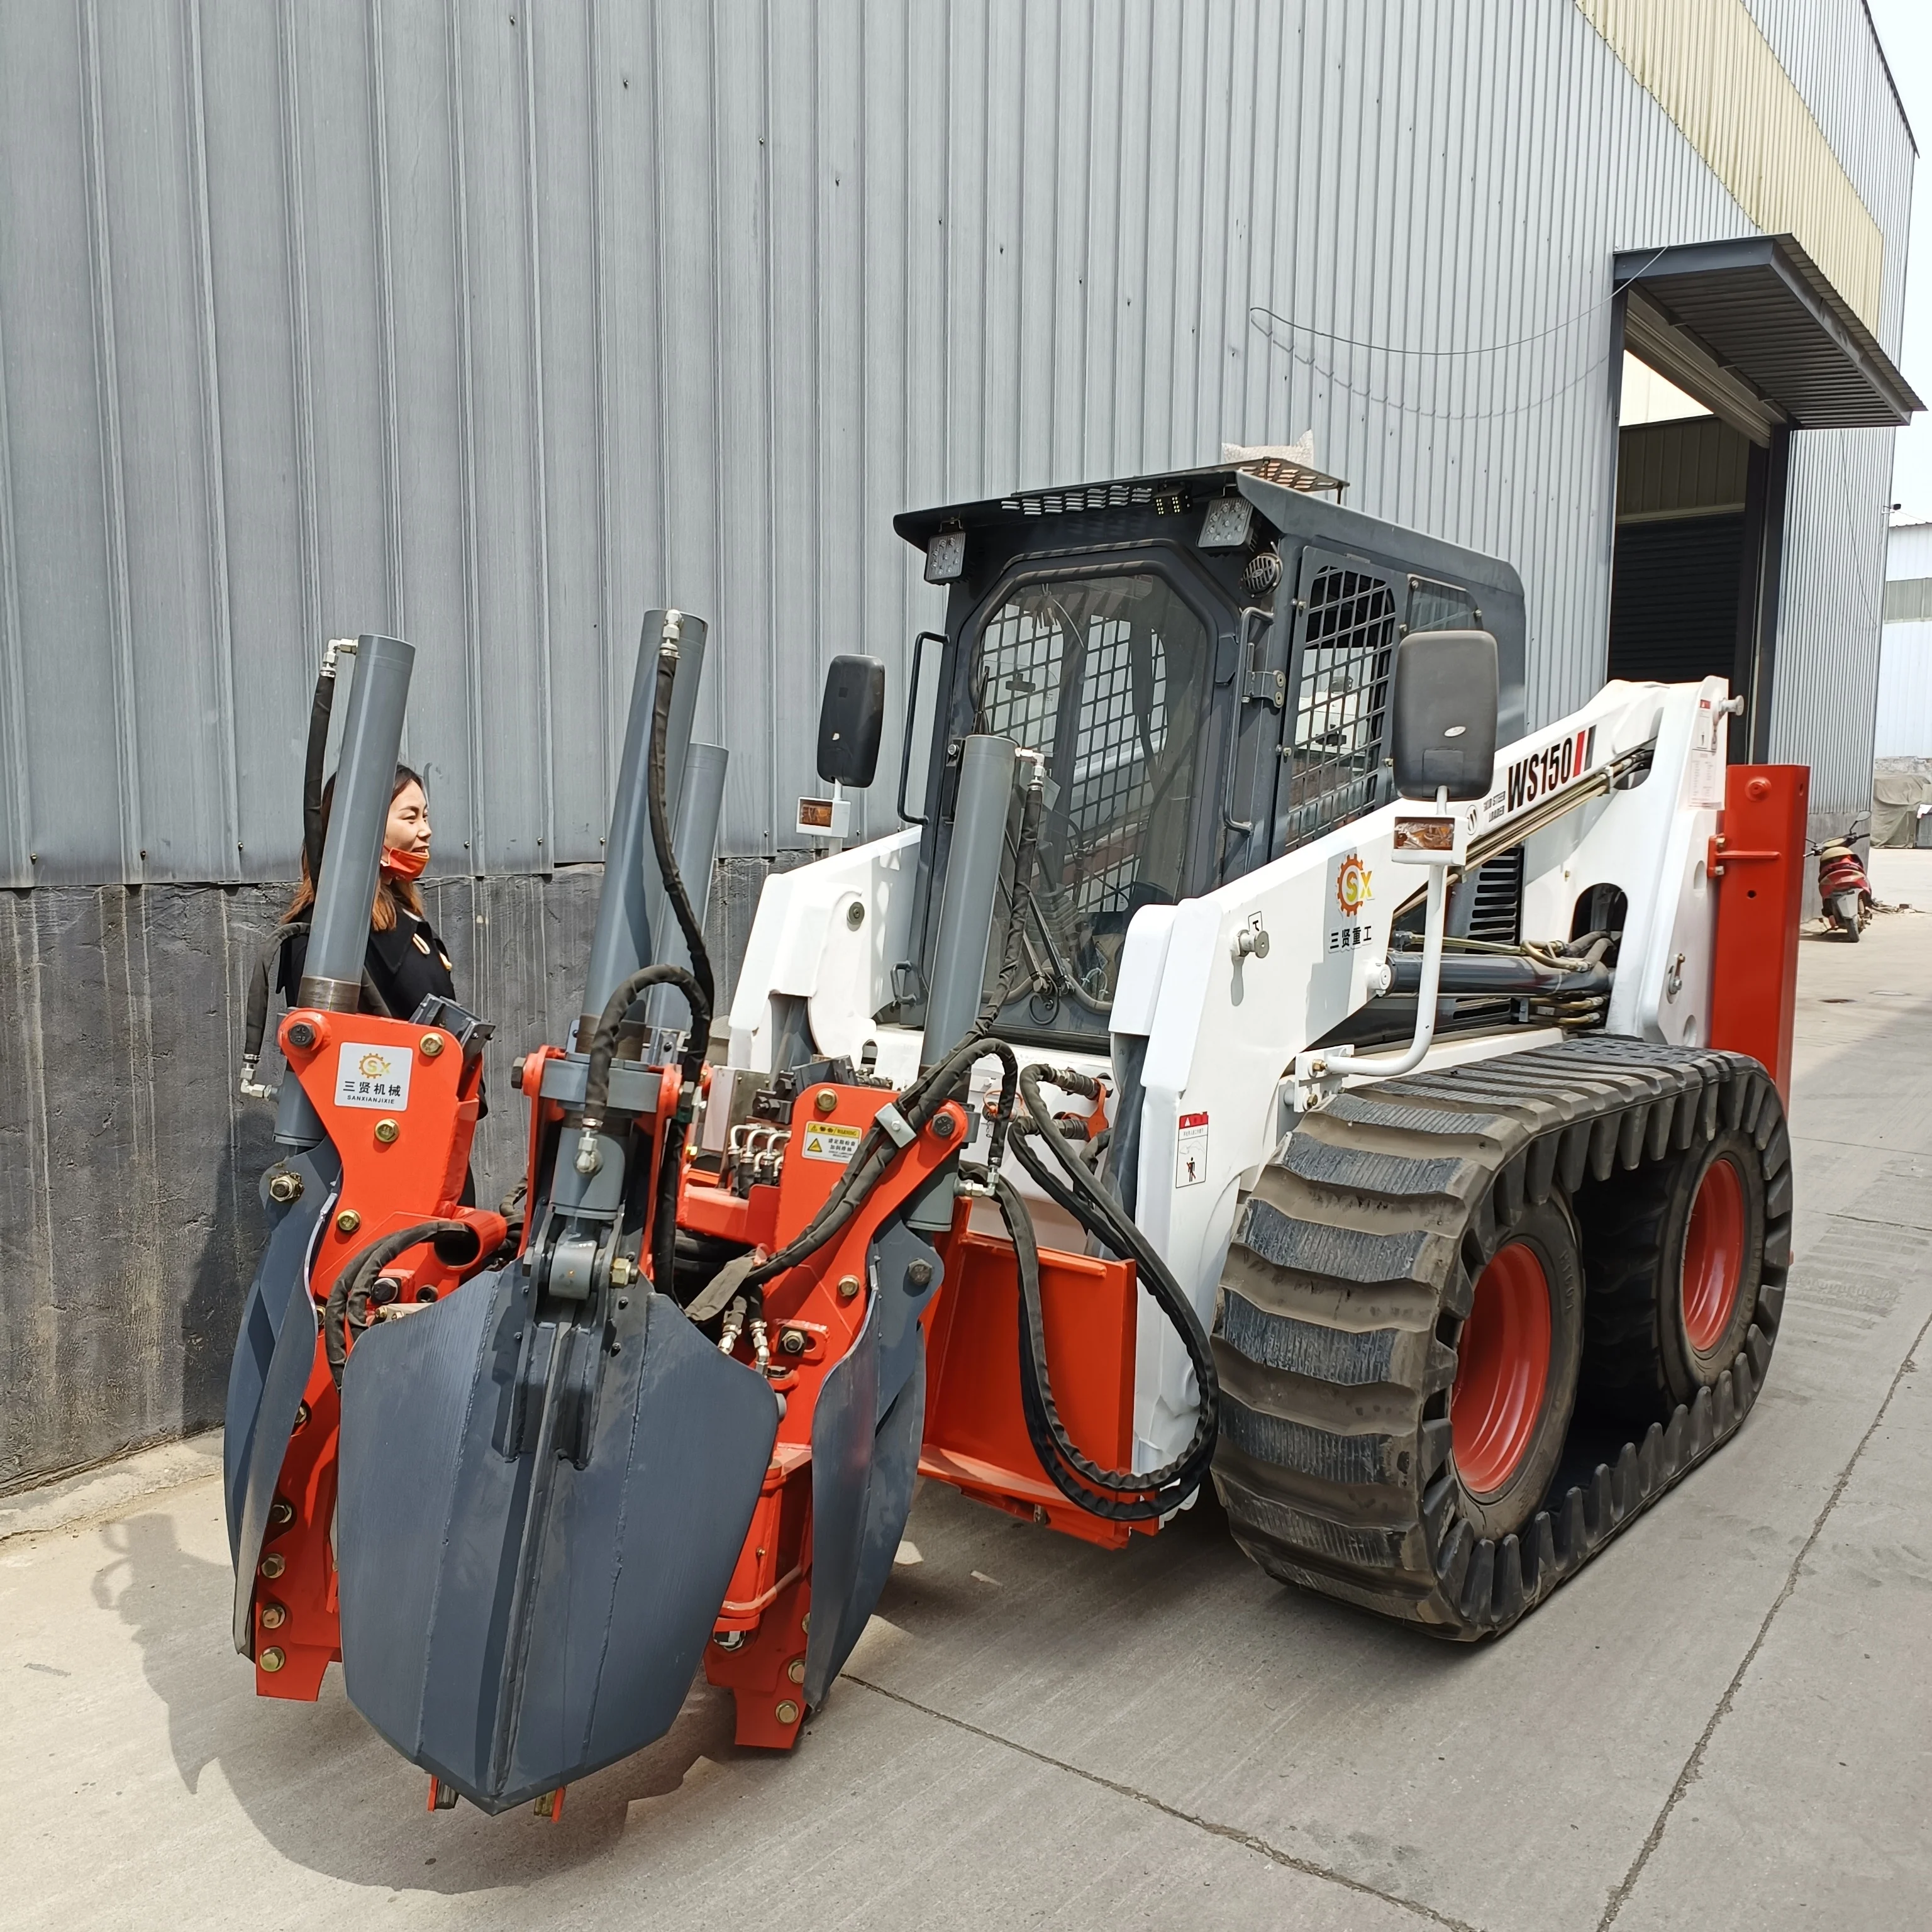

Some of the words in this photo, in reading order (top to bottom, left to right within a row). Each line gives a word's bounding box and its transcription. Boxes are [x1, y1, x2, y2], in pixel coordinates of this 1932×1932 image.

[1507, 737, 1573, 813] WS150
[1330, 926, 1372, 949] 三贤重工
[343, 1080, 401, 1097] 三贤机械
[347, 1095, 395, 1104] SANXIANJIXIE
